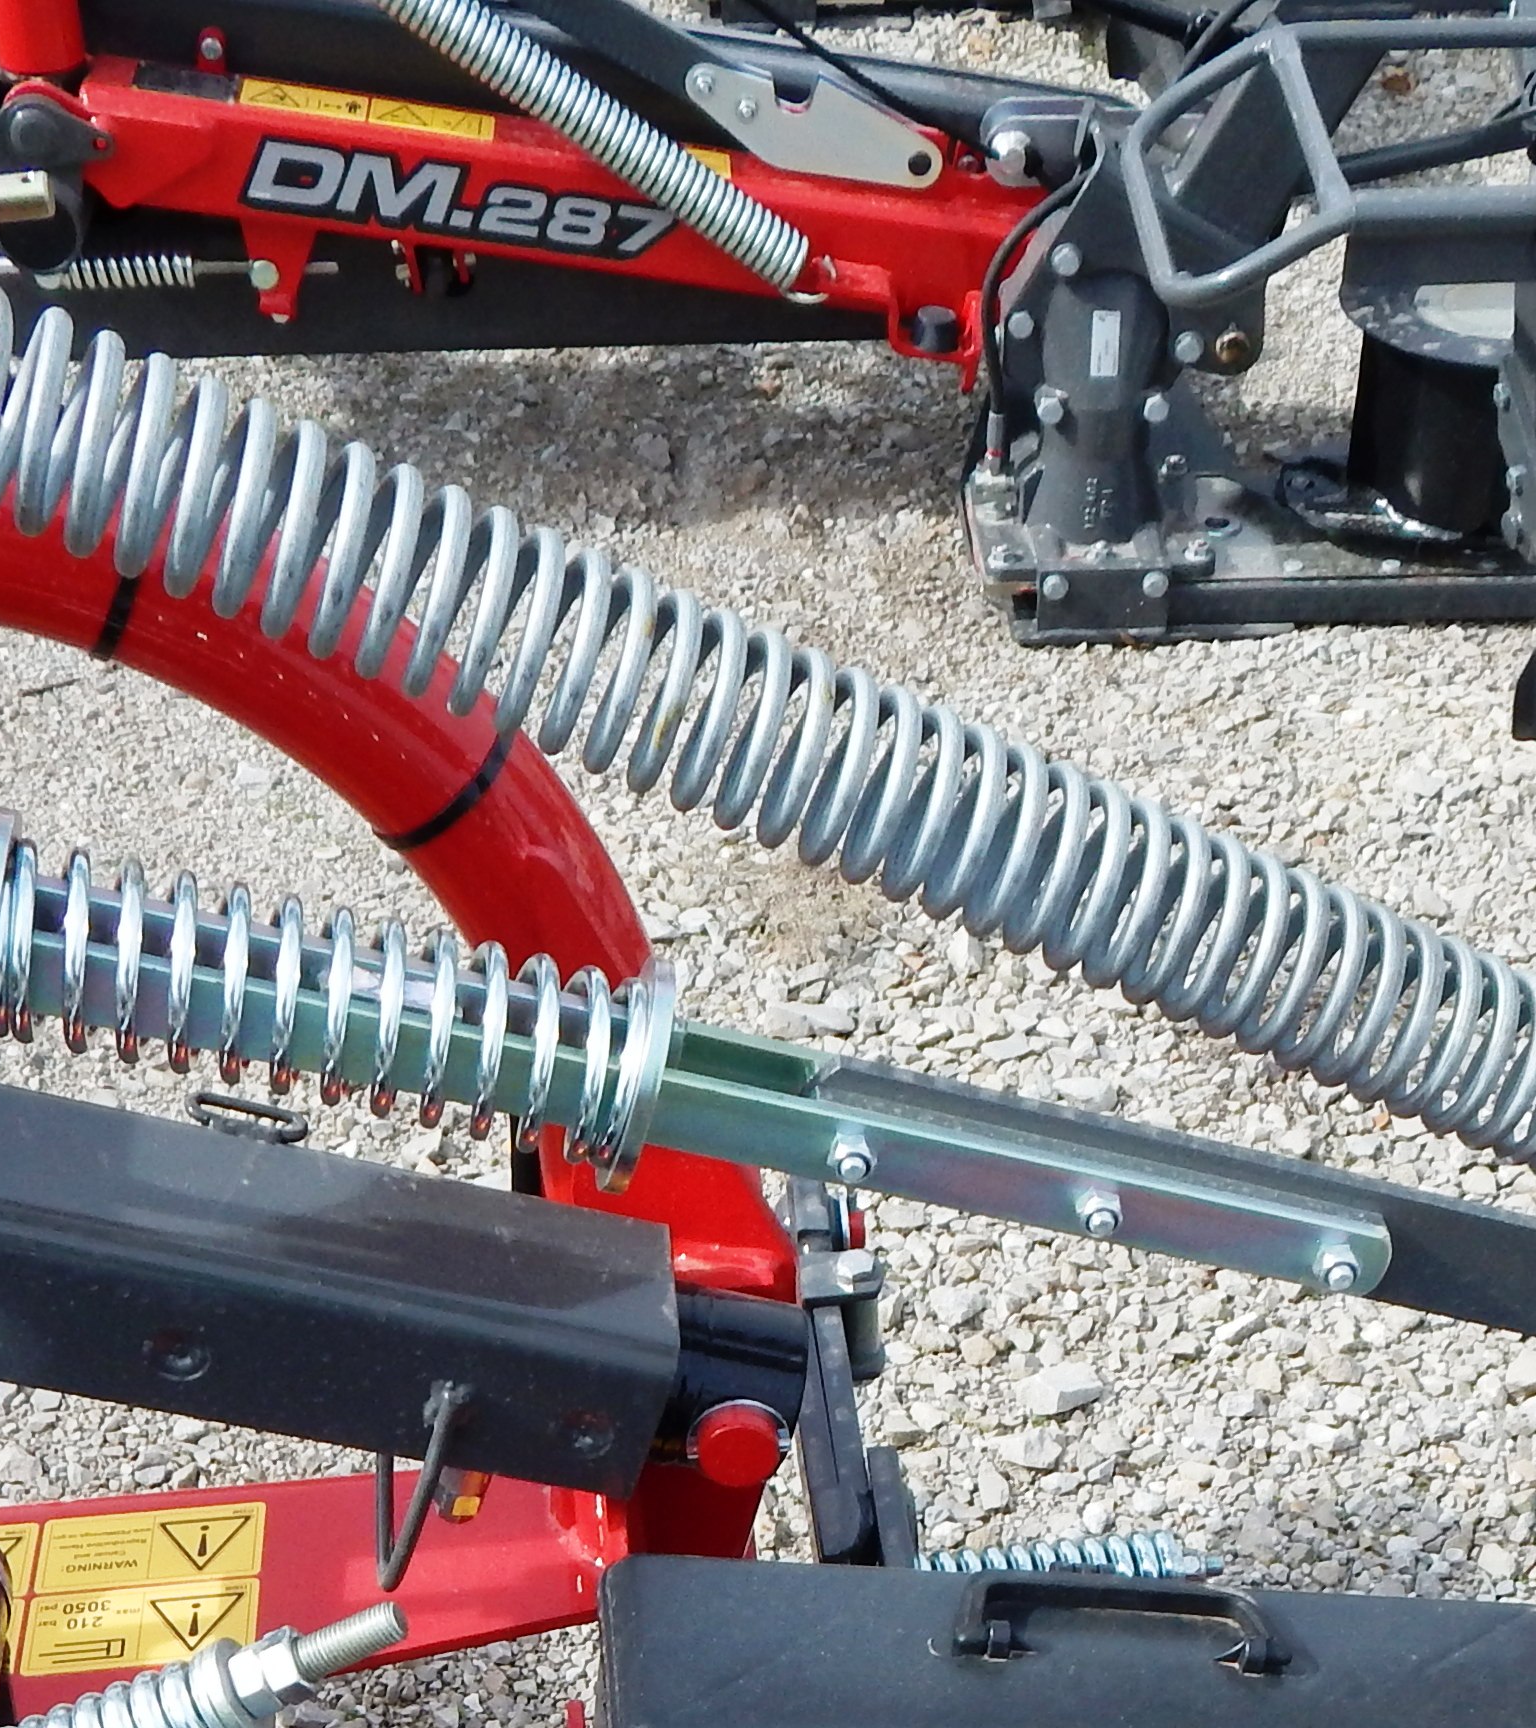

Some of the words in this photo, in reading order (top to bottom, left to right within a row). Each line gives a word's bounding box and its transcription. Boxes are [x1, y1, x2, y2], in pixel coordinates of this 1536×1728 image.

[247, 140, 674, 253] DM.287
[39, 1603, 58, 1613] psi
[62, 1599, 111, 1615] 3050
[38, 1618, 57, 1628] bar
[66, 1616, 104, 1630] 210
